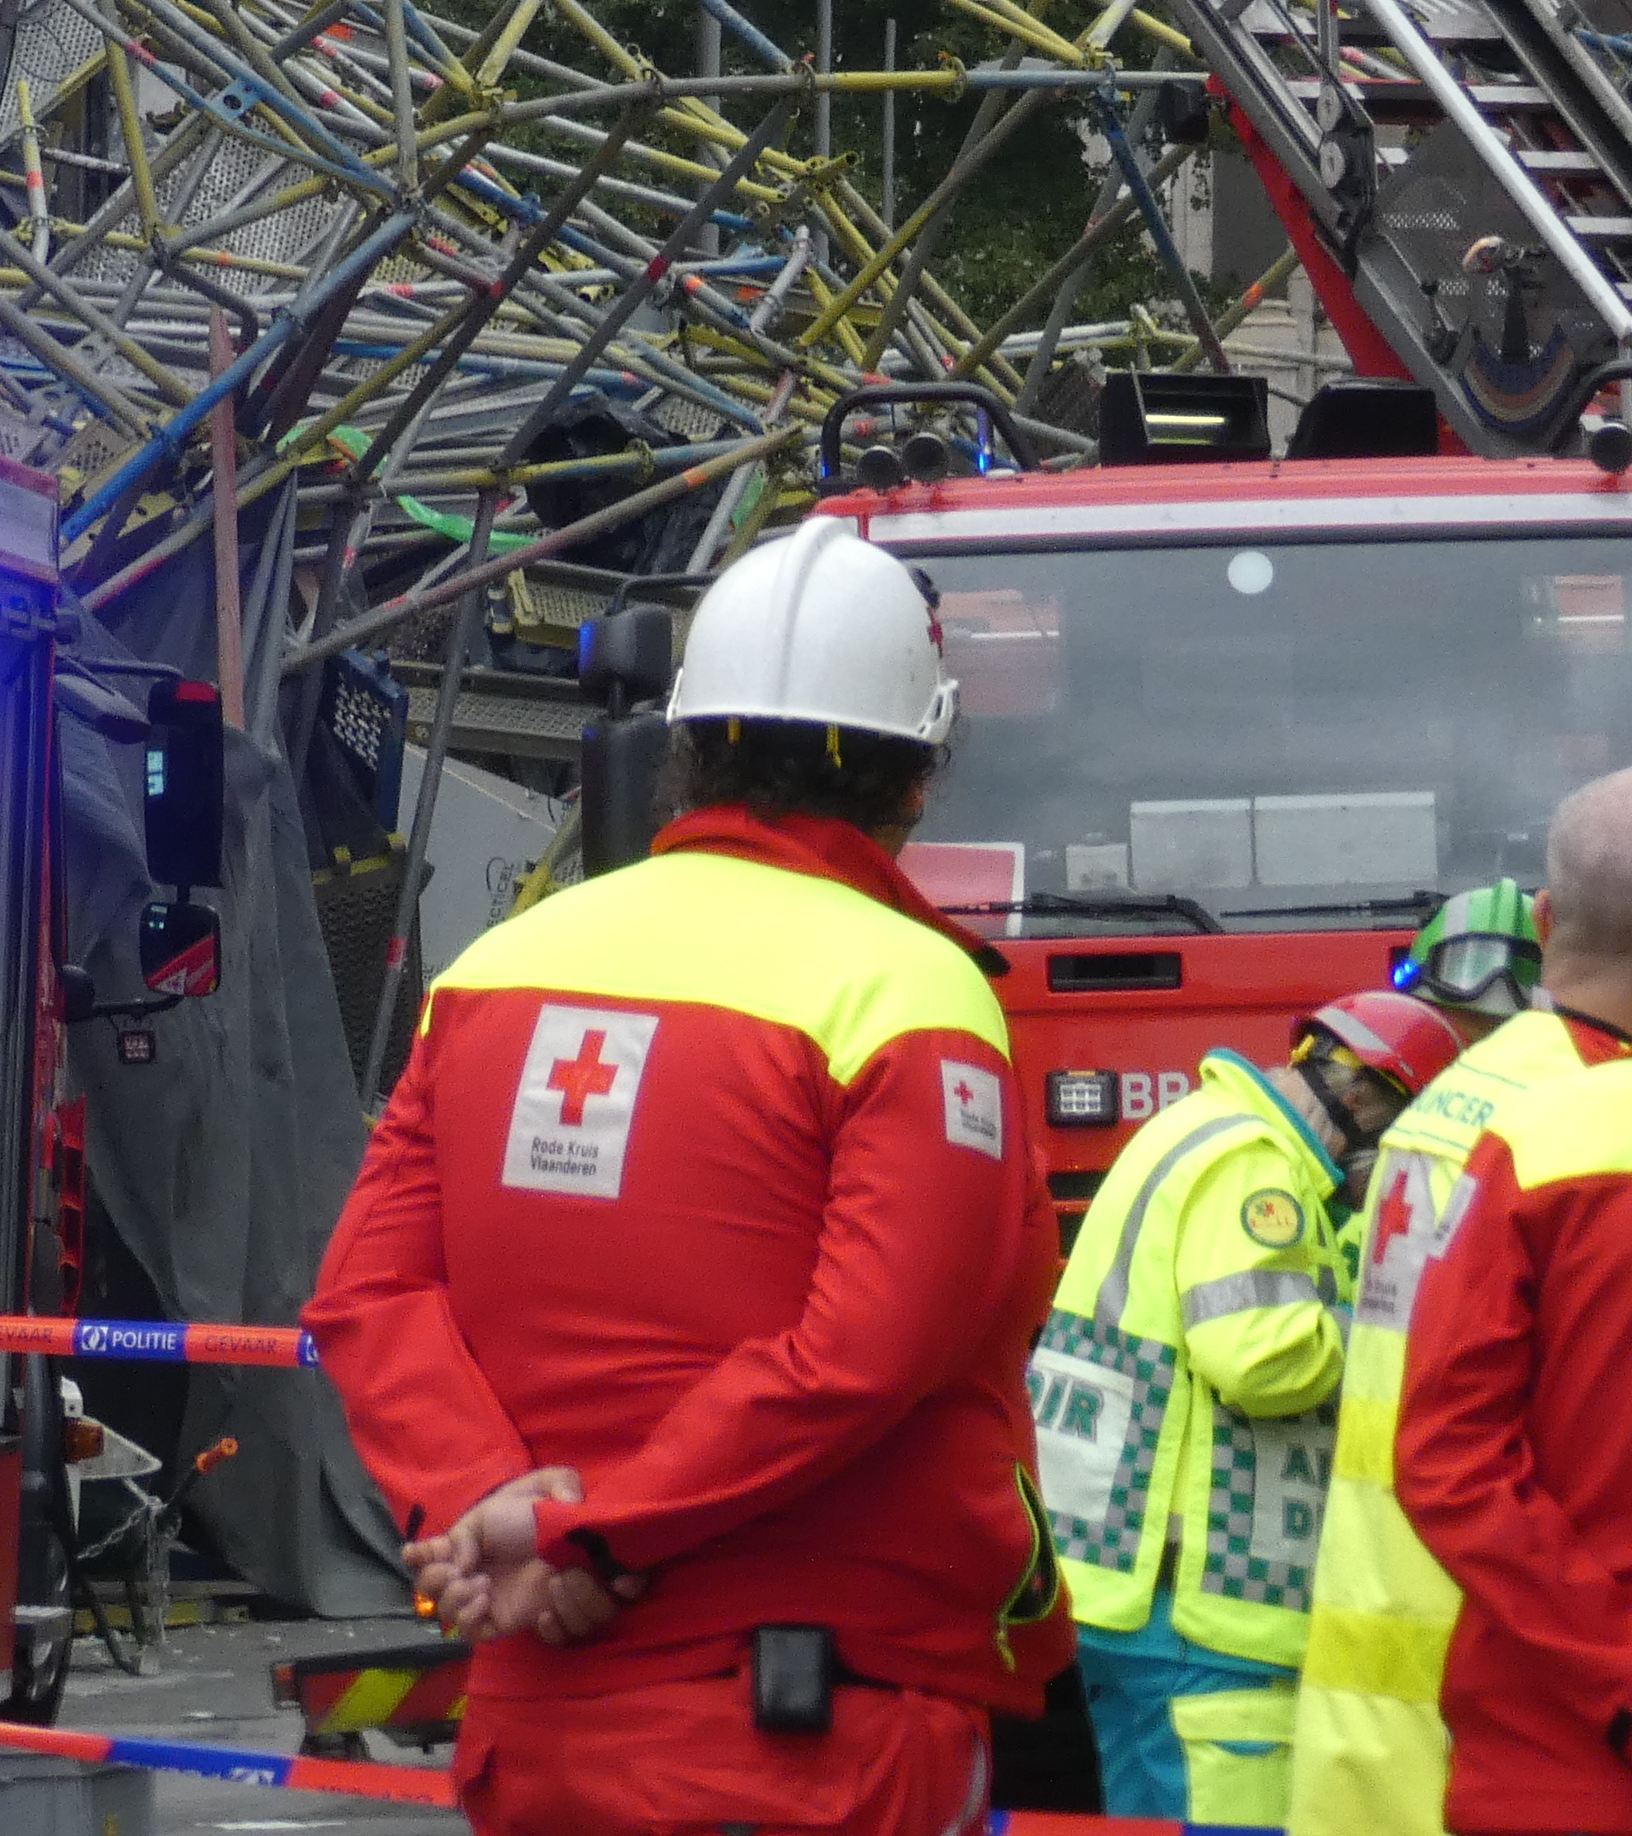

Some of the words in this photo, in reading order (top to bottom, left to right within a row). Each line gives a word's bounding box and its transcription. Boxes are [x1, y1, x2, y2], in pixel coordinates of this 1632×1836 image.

[531, 1136, 564, 1155] Rode
[567, 1140, 600, 1158] Kruis
[530, 1155, 597, 1176] Vlaanderen
[112, 1331, 177, 1351] POLITIE
[204, 1334, 278, 1355] GEVAAR
